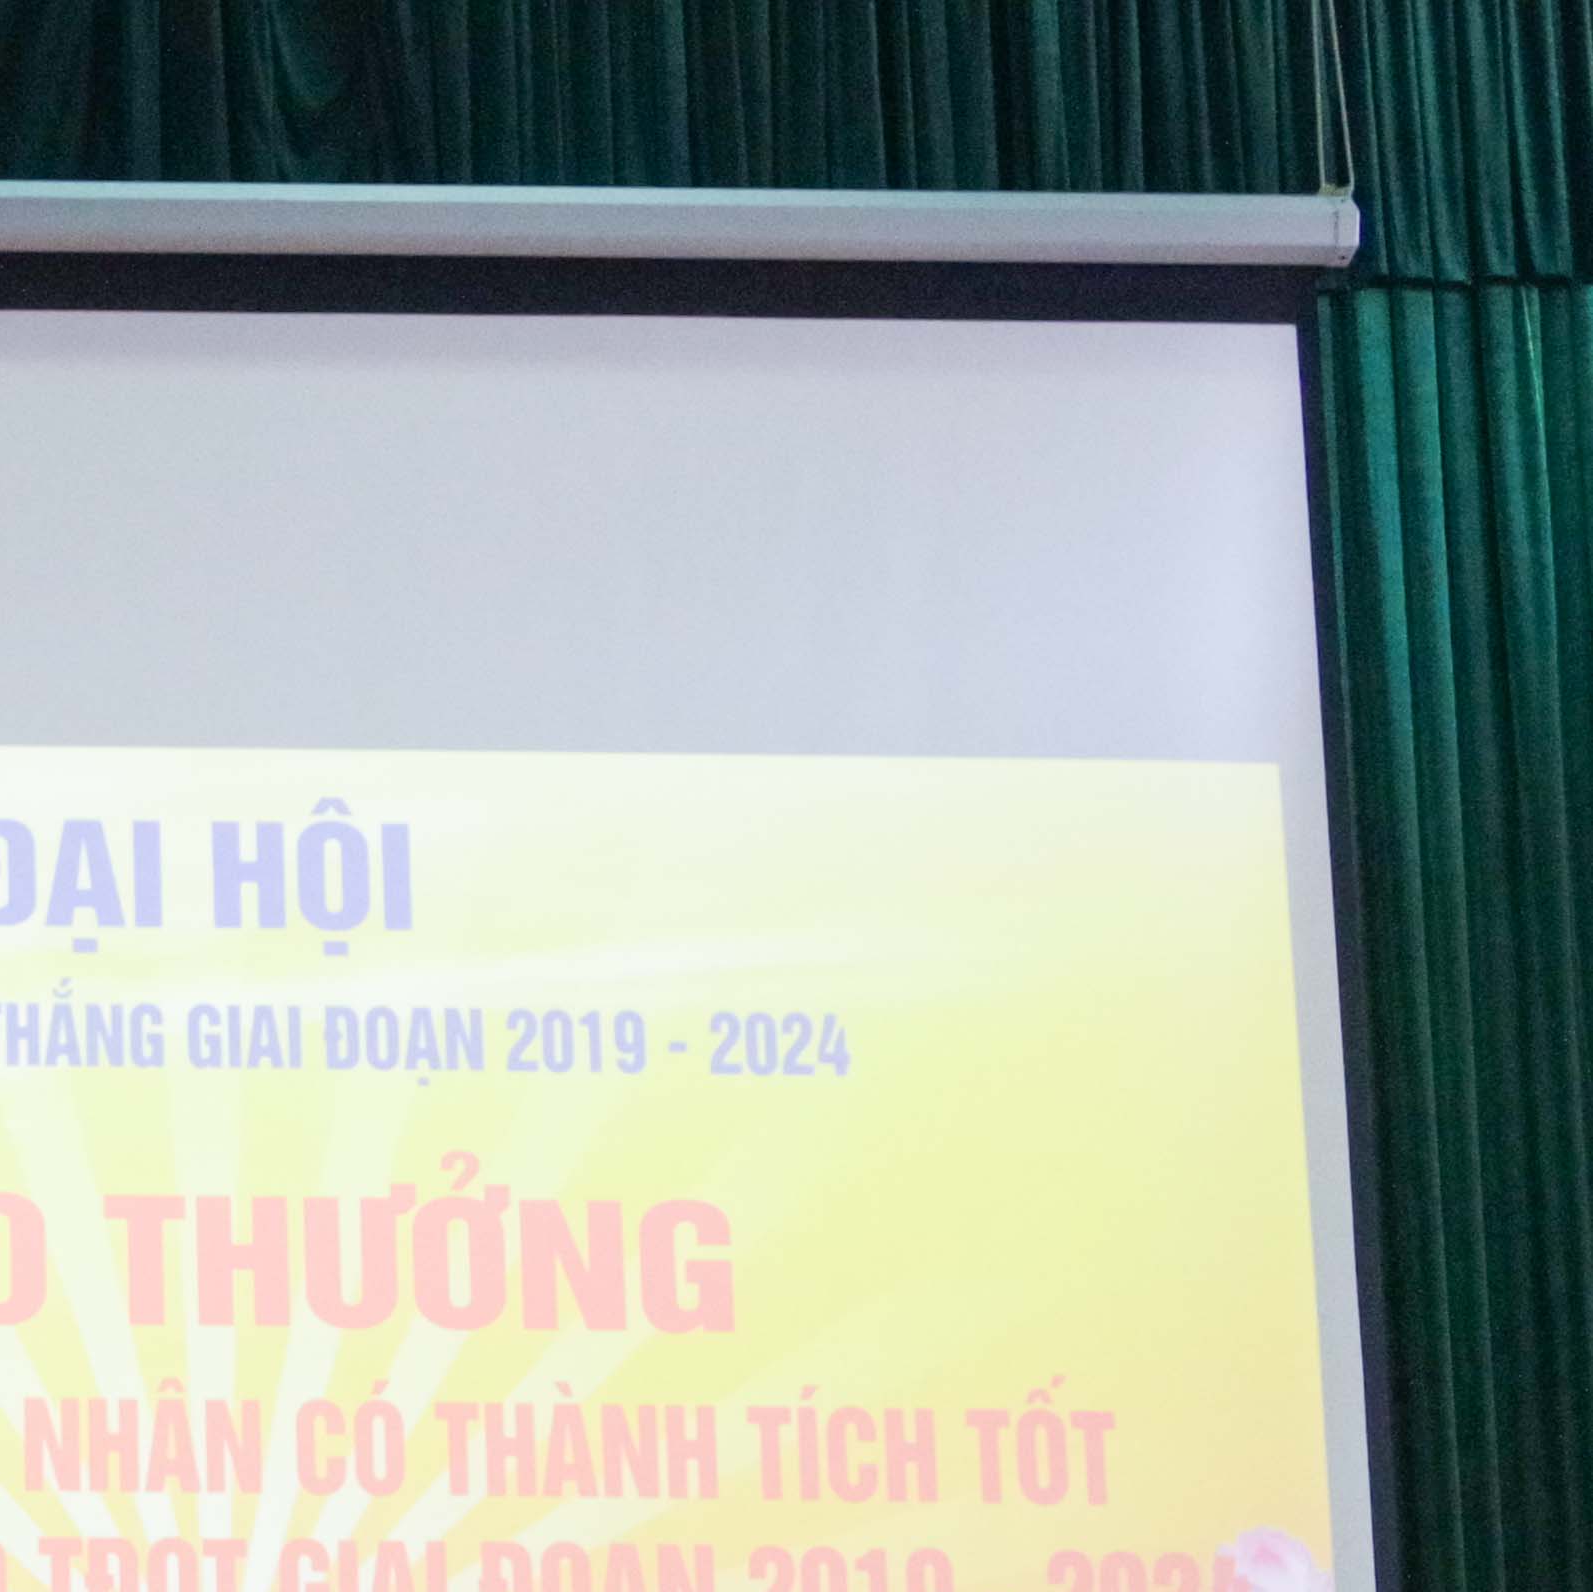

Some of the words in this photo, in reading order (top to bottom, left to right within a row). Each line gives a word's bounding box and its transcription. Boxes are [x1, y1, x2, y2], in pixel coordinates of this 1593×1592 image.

[211, 796, 413, 957] HỘI
[186, 1003, 302, 1070] GIAI
[323, 1005, 484, 1086] ĐOẠN
[505, 1008, 647, 1074] 2019
[708, 1011, 851, 1077] 2024
[102, 1150, 737, 1334] THƯỞNG
[23, 1377, 263, 1494] NHÂN
[295, 1379, 406, 1498] CÓ
[434, 1380, 719, 1499] THÀNH
[746, 1384, 939, 1505] TÍCH
[965, 1374, 1115, 1505] TỐT
